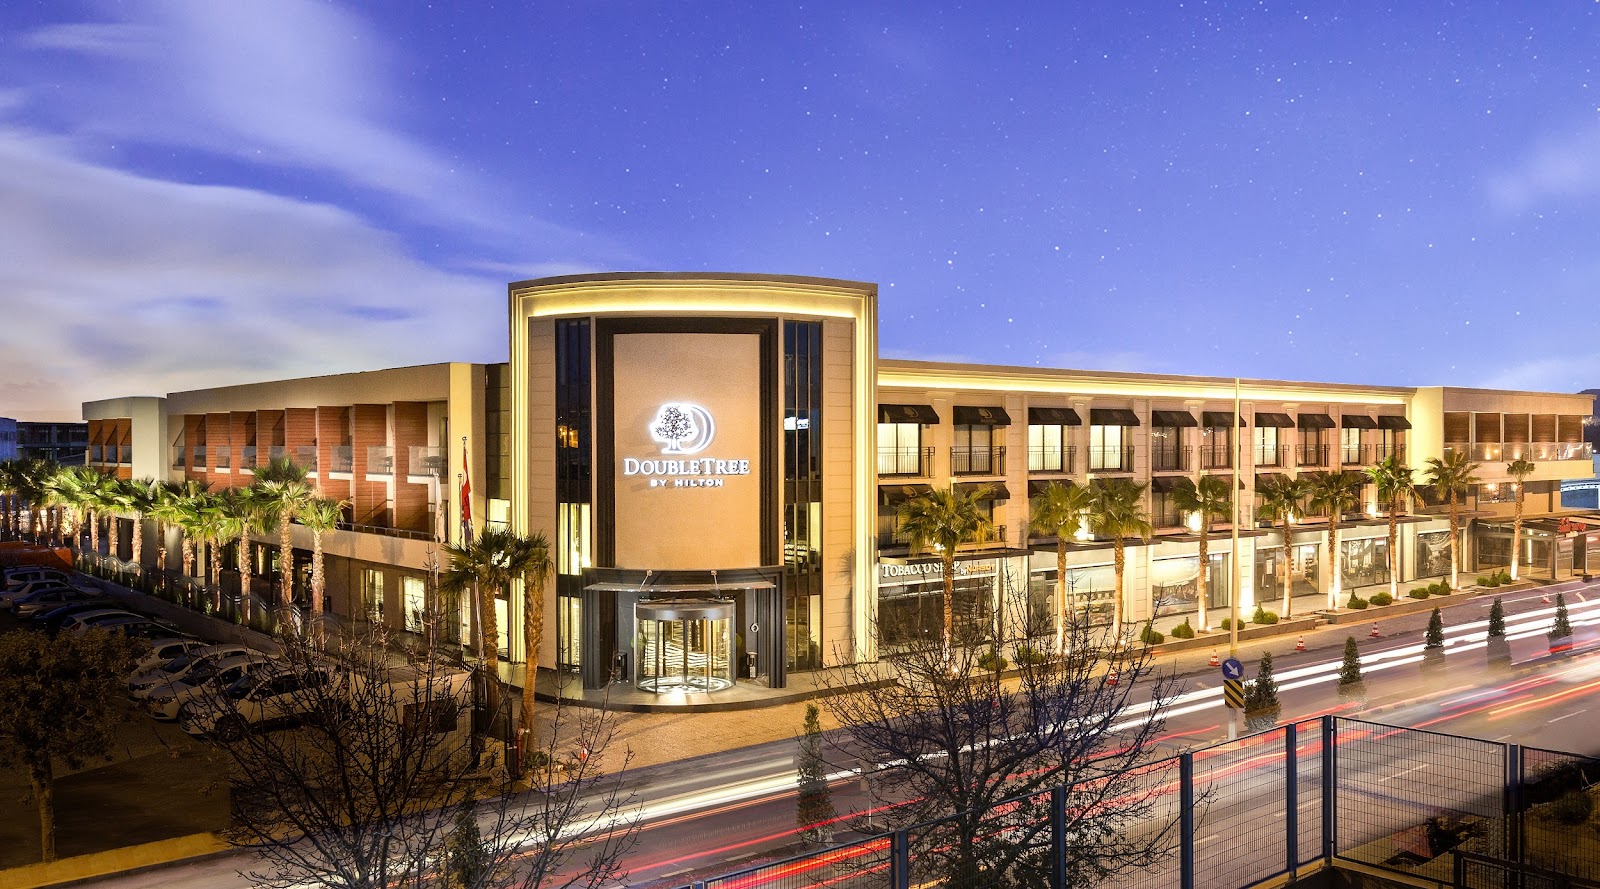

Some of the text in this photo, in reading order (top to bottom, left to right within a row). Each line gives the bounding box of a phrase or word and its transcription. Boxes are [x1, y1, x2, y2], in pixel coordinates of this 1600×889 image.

[624, 458, 750, 475] DOUBLETREE
[650, 479, 723, 487] BY HILTON
[881, 563, 932, 577] TOBACCO
[932, 561, 960, 573] SHP
